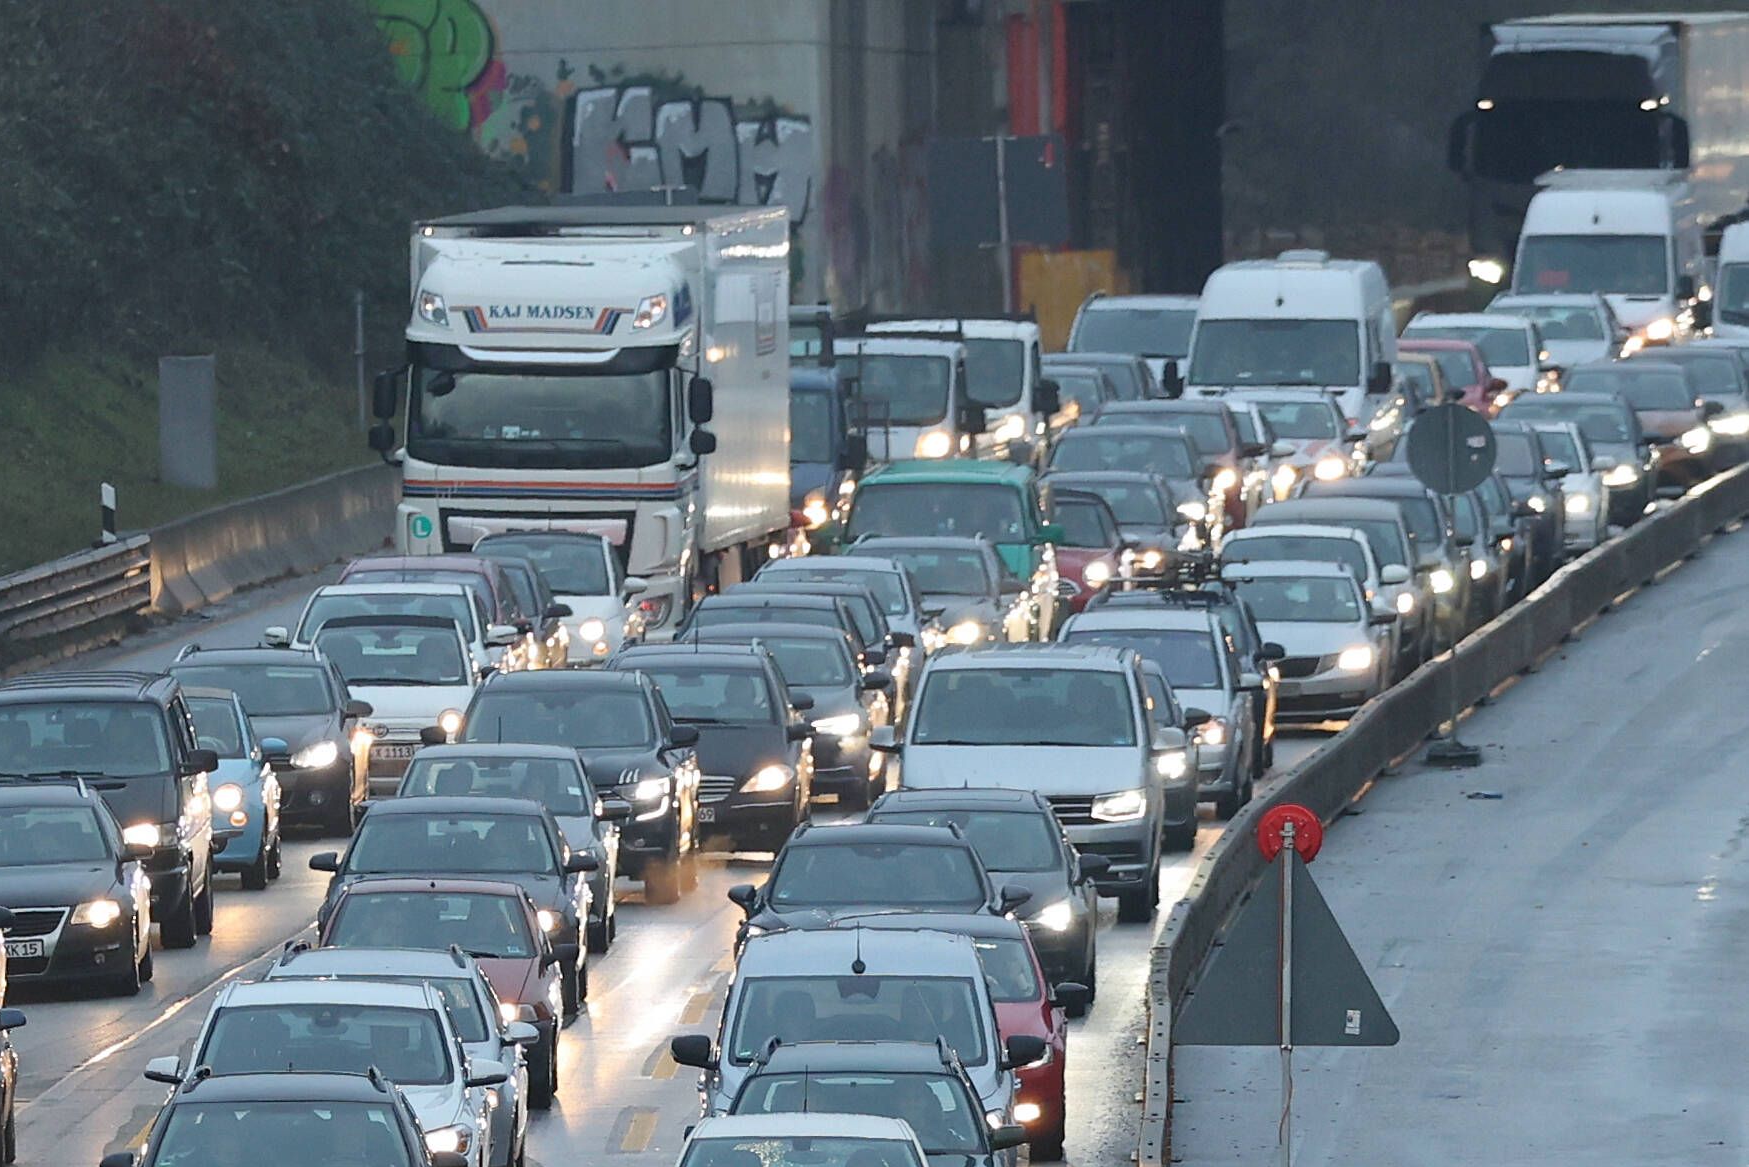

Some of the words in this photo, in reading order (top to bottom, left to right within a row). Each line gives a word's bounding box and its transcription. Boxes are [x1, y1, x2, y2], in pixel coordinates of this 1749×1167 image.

[489, 304, 521, 318] KAJ
[527, 304, 594, 320] MADSEN
[22, 943, 37, 956] 15
